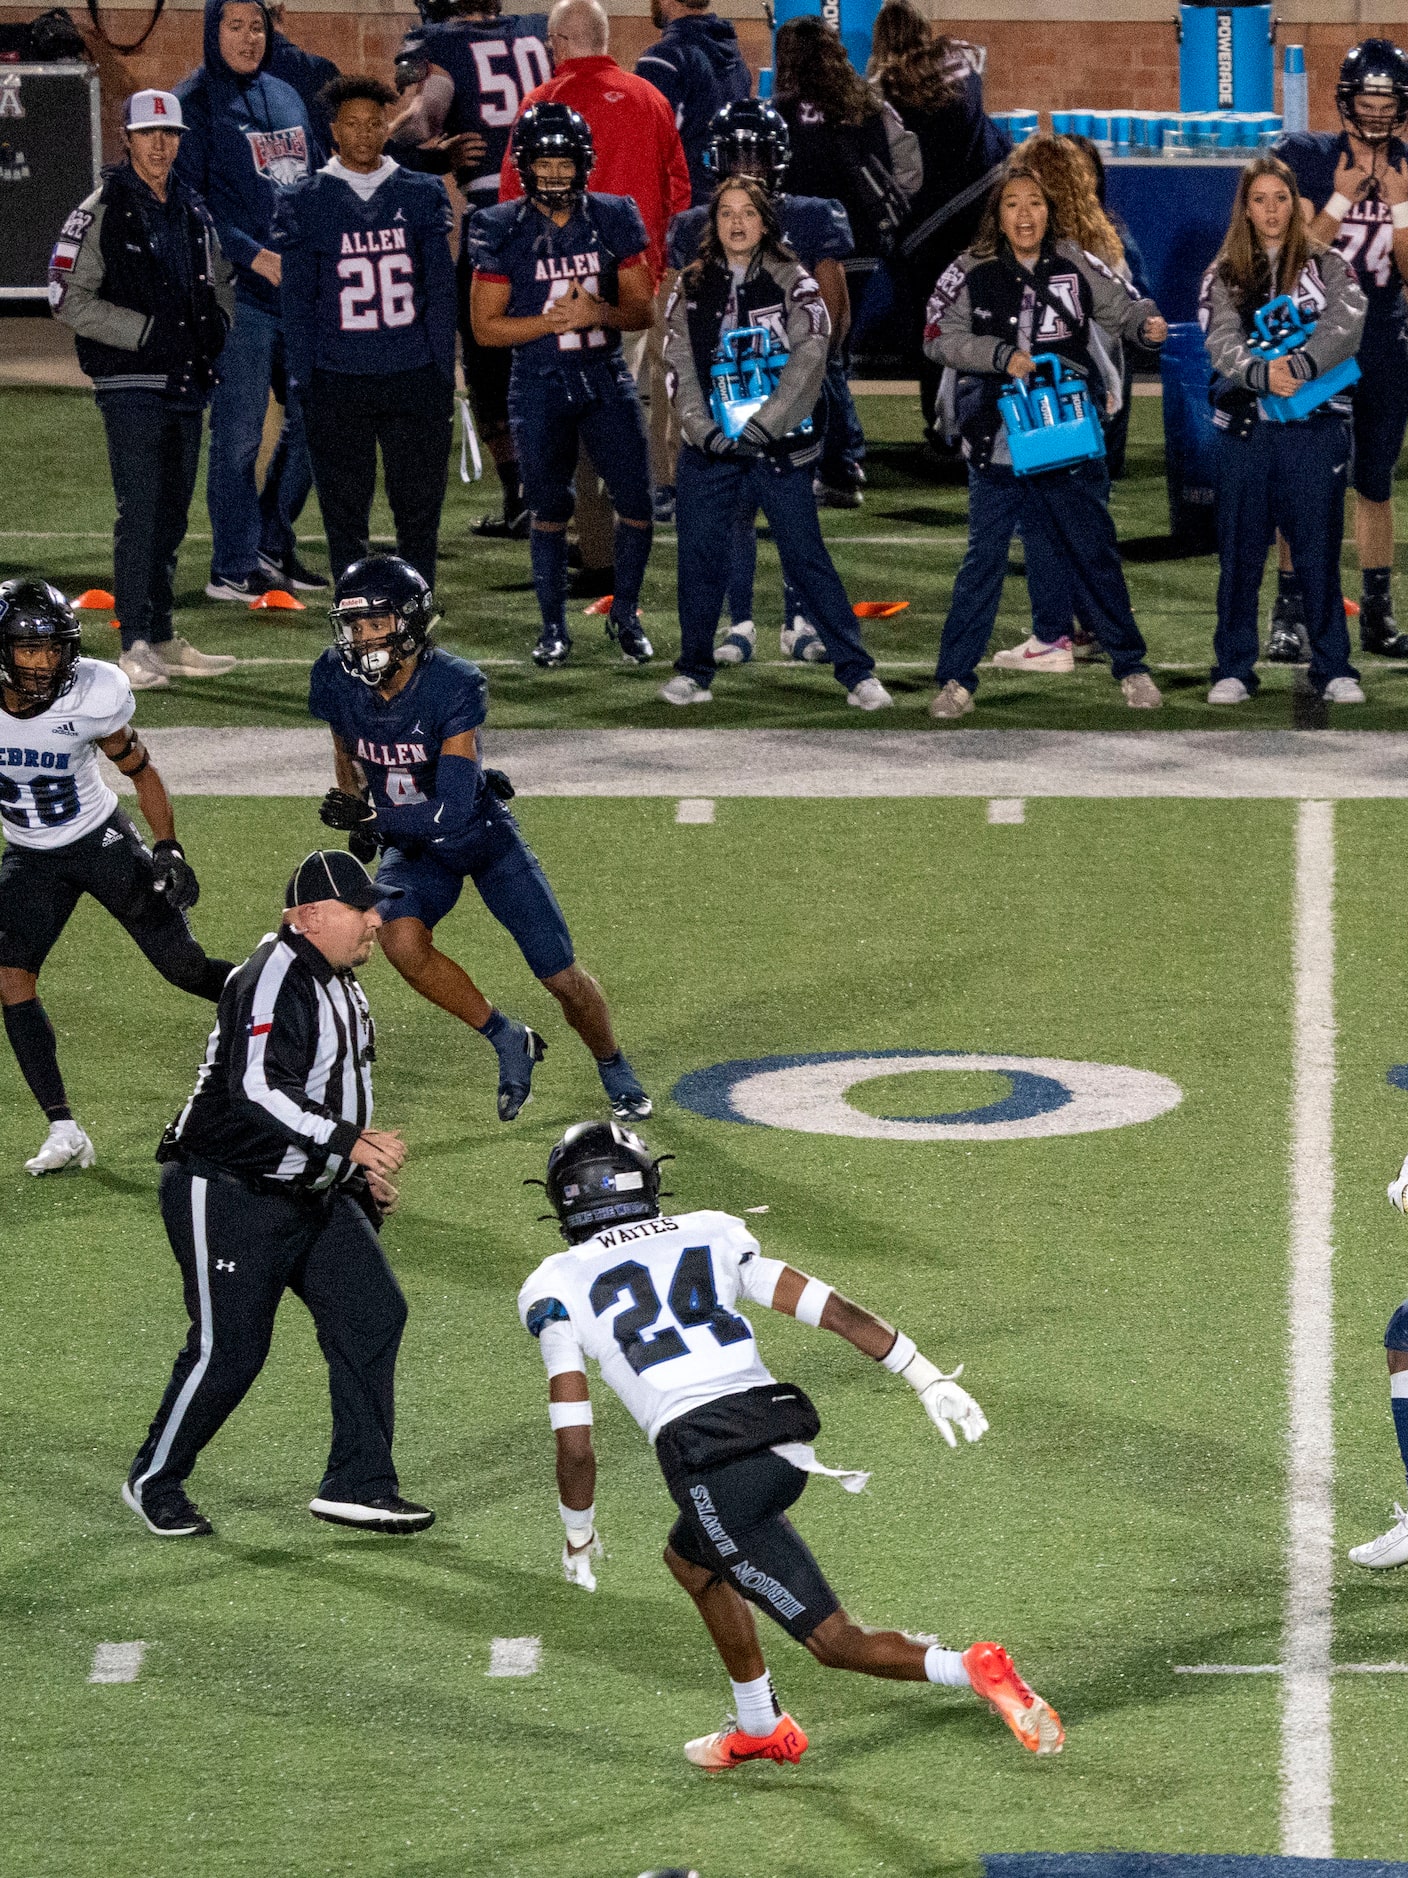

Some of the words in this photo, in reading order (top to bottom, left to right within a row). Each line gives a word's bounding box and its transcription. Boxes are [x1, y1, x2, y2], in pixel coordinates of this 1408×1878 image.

[468, 35, 551, 128] 50
[1217, 15, 1233, 105] POWERADE
[153, 98, 167, 115] A
[340, 227, 407, 255] ALLEN
[534, 251, 601, 281] ALLEN
[1334, 222, 1393, 288] 74
[336, 253, 416, 331] 26
[357, 738, 428, 766] ALLEN
[386, 766, 428, 807] 4
[596, 1217, 679, 1248] WAITES
[589, 1245, 753, 1375] 24
[690, 1484, 739, 1557] HAWKS
[730, 1560, 807, 1620] HEBRON
